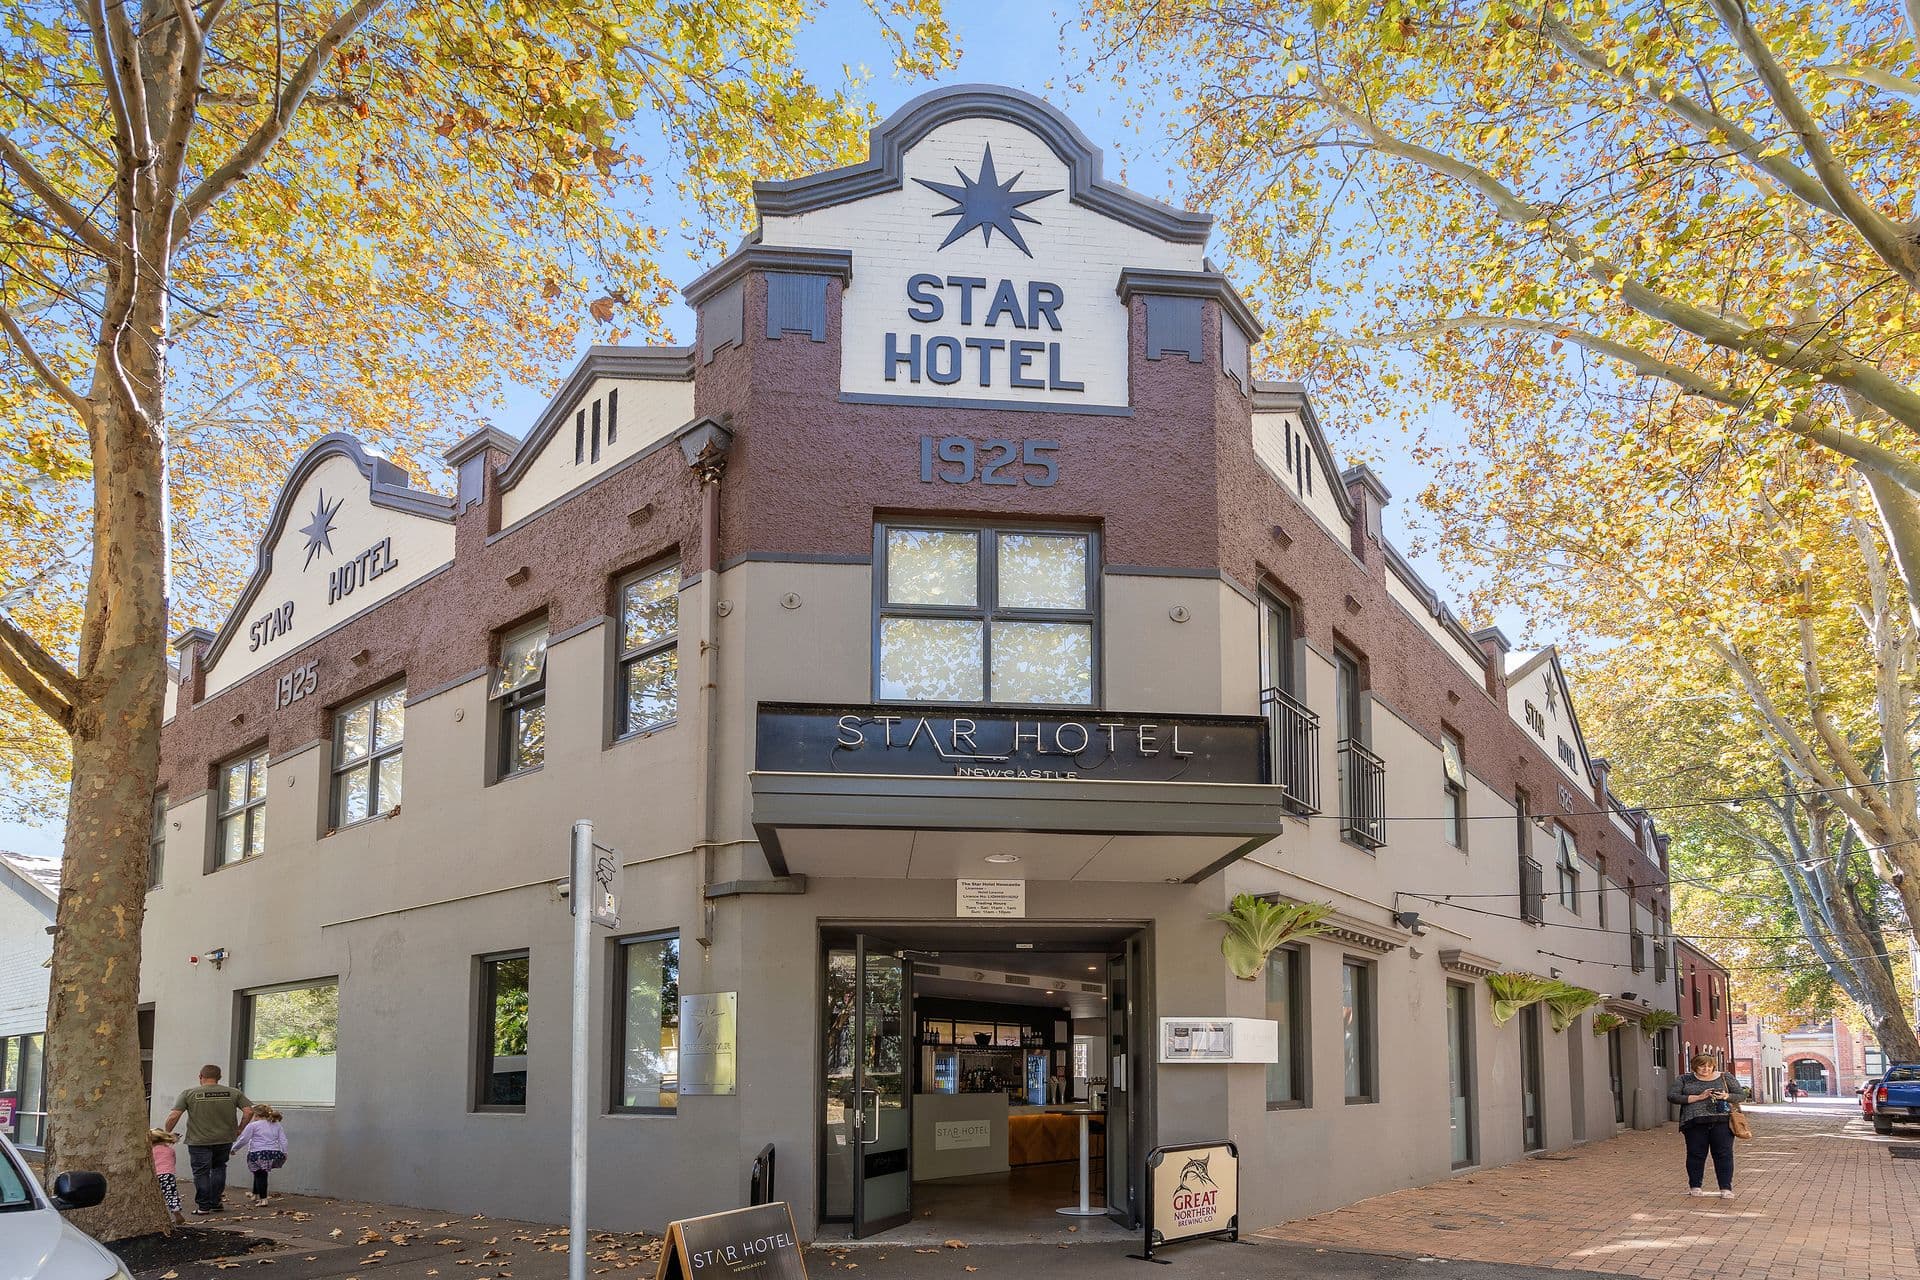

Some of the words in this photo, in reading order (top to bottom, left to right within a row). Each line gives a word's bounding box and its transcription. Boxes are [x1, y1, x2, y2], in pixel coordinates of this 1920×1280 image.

[907, 273, 1064, 331] STAR
[885, 333, 1084, 392] HOTEL
[920, 435, 1061, 487] 1925
[249, 601, 294, 652] STAR
[328, 537, 398, 605] HOTEL
[275, 659, 320, 711] 1925
[837, 715, 985, 757] STAR
[1015, 720, 1194, 756] HOTEL
[1525, 699, 1545, 740] STAR
[1557, 735, 1578, 775] HOTEL
[936, 1128, 959, 1138] STAR
[962, 1126, 988, 1135] HOTEL
[1173, 1190, 1218, 1210] GREAT
[1174, 1206, 1217, 1221] NORTHERN
[1178, 1217, 1202, 1228] BREWING
[694, 1246, 740, 1268] STAR
[742, 1232, 794, 1256] HOTEL
[733, 1260, 767, 1273] NEWCASTLE
